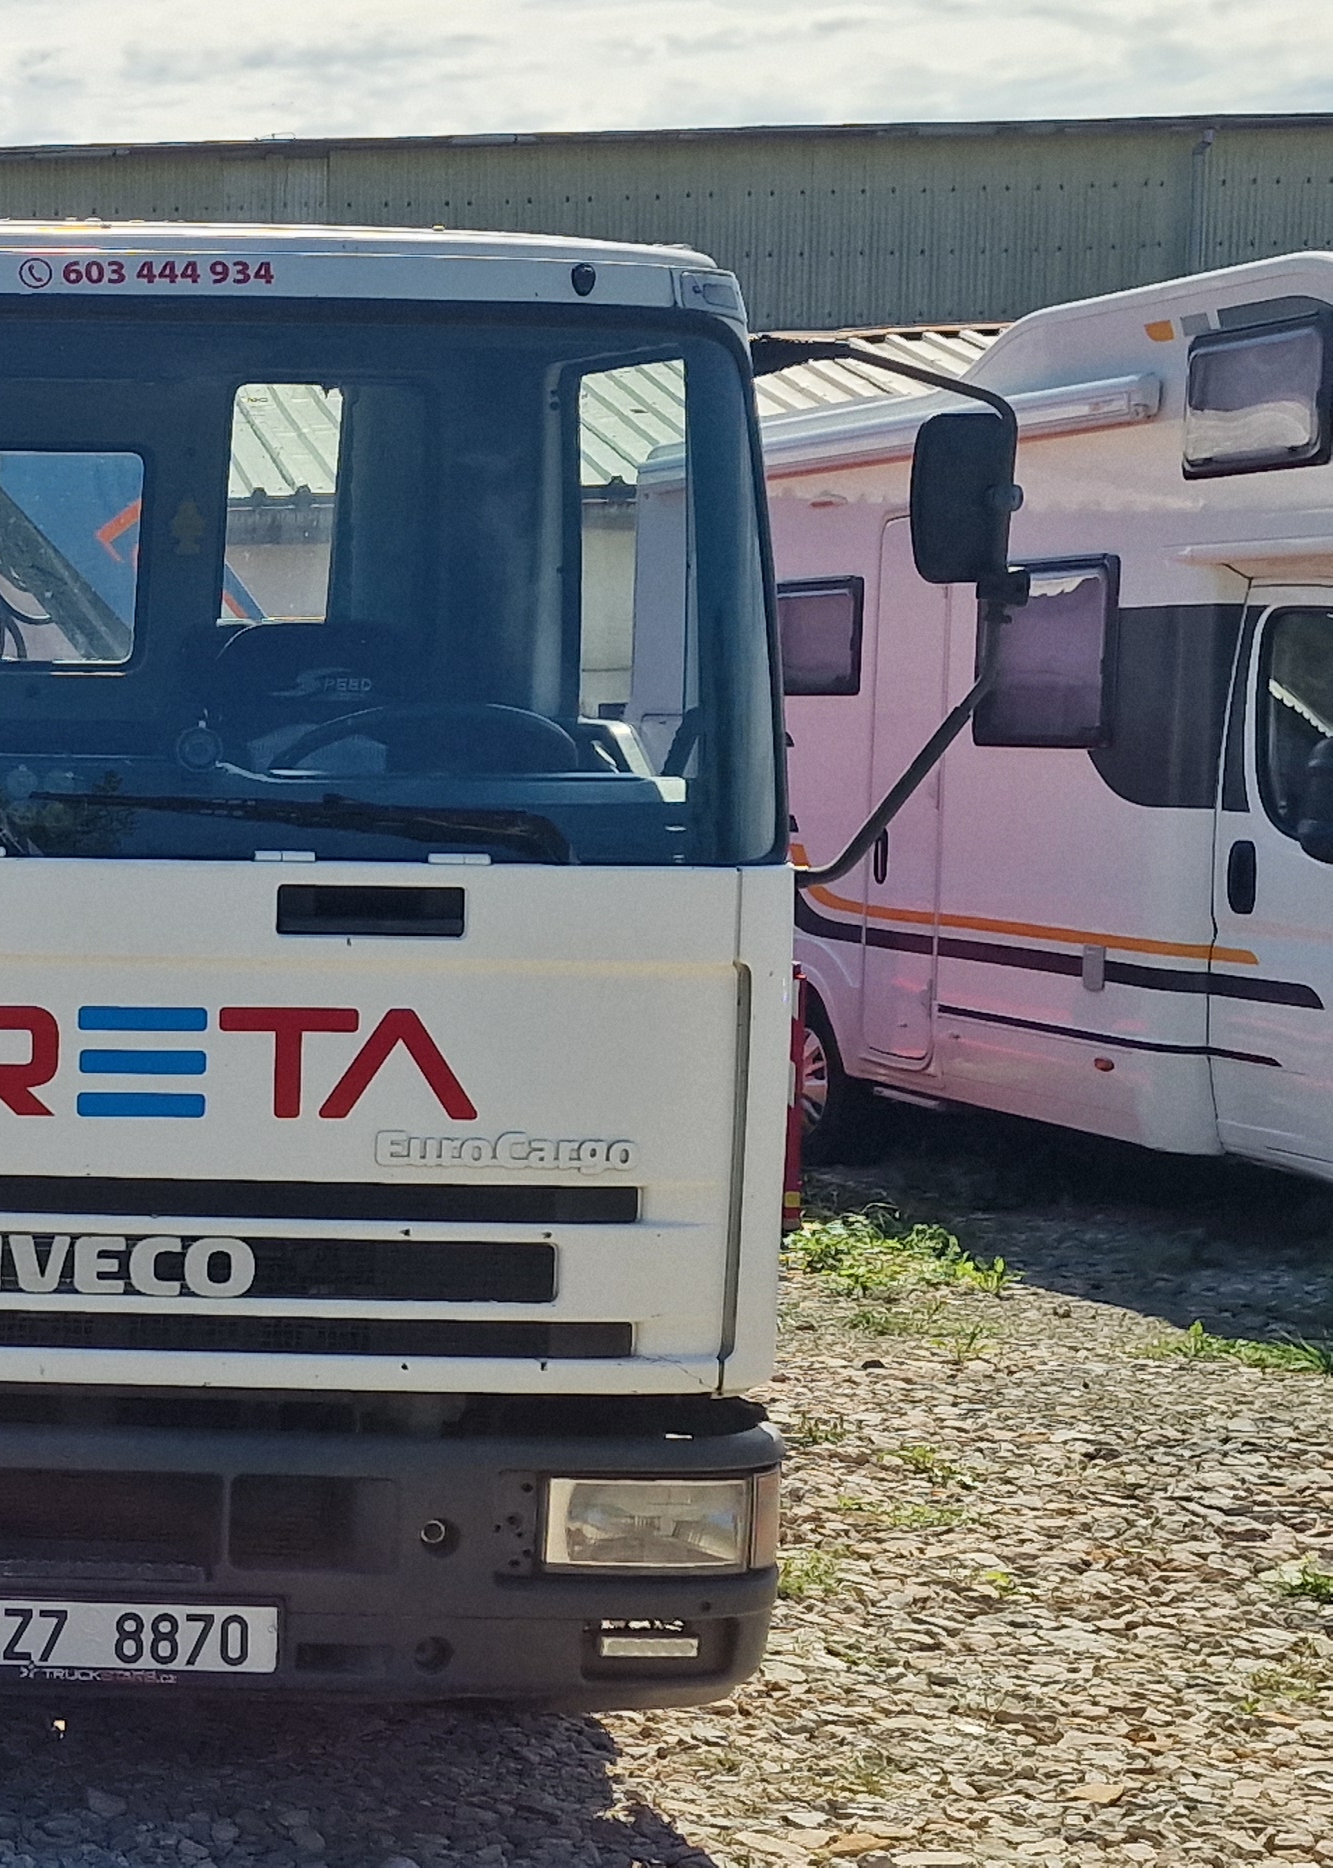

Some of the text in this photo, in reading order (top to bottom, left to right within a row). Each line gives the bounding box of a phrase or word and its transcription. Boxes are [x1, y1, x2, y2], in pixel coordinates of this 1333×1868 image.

[63, 260, 274, 285] 603 444 934
[375, 1130, 637, 1174] EuroCargo
[114, 1612, 249, 1667] 8870
